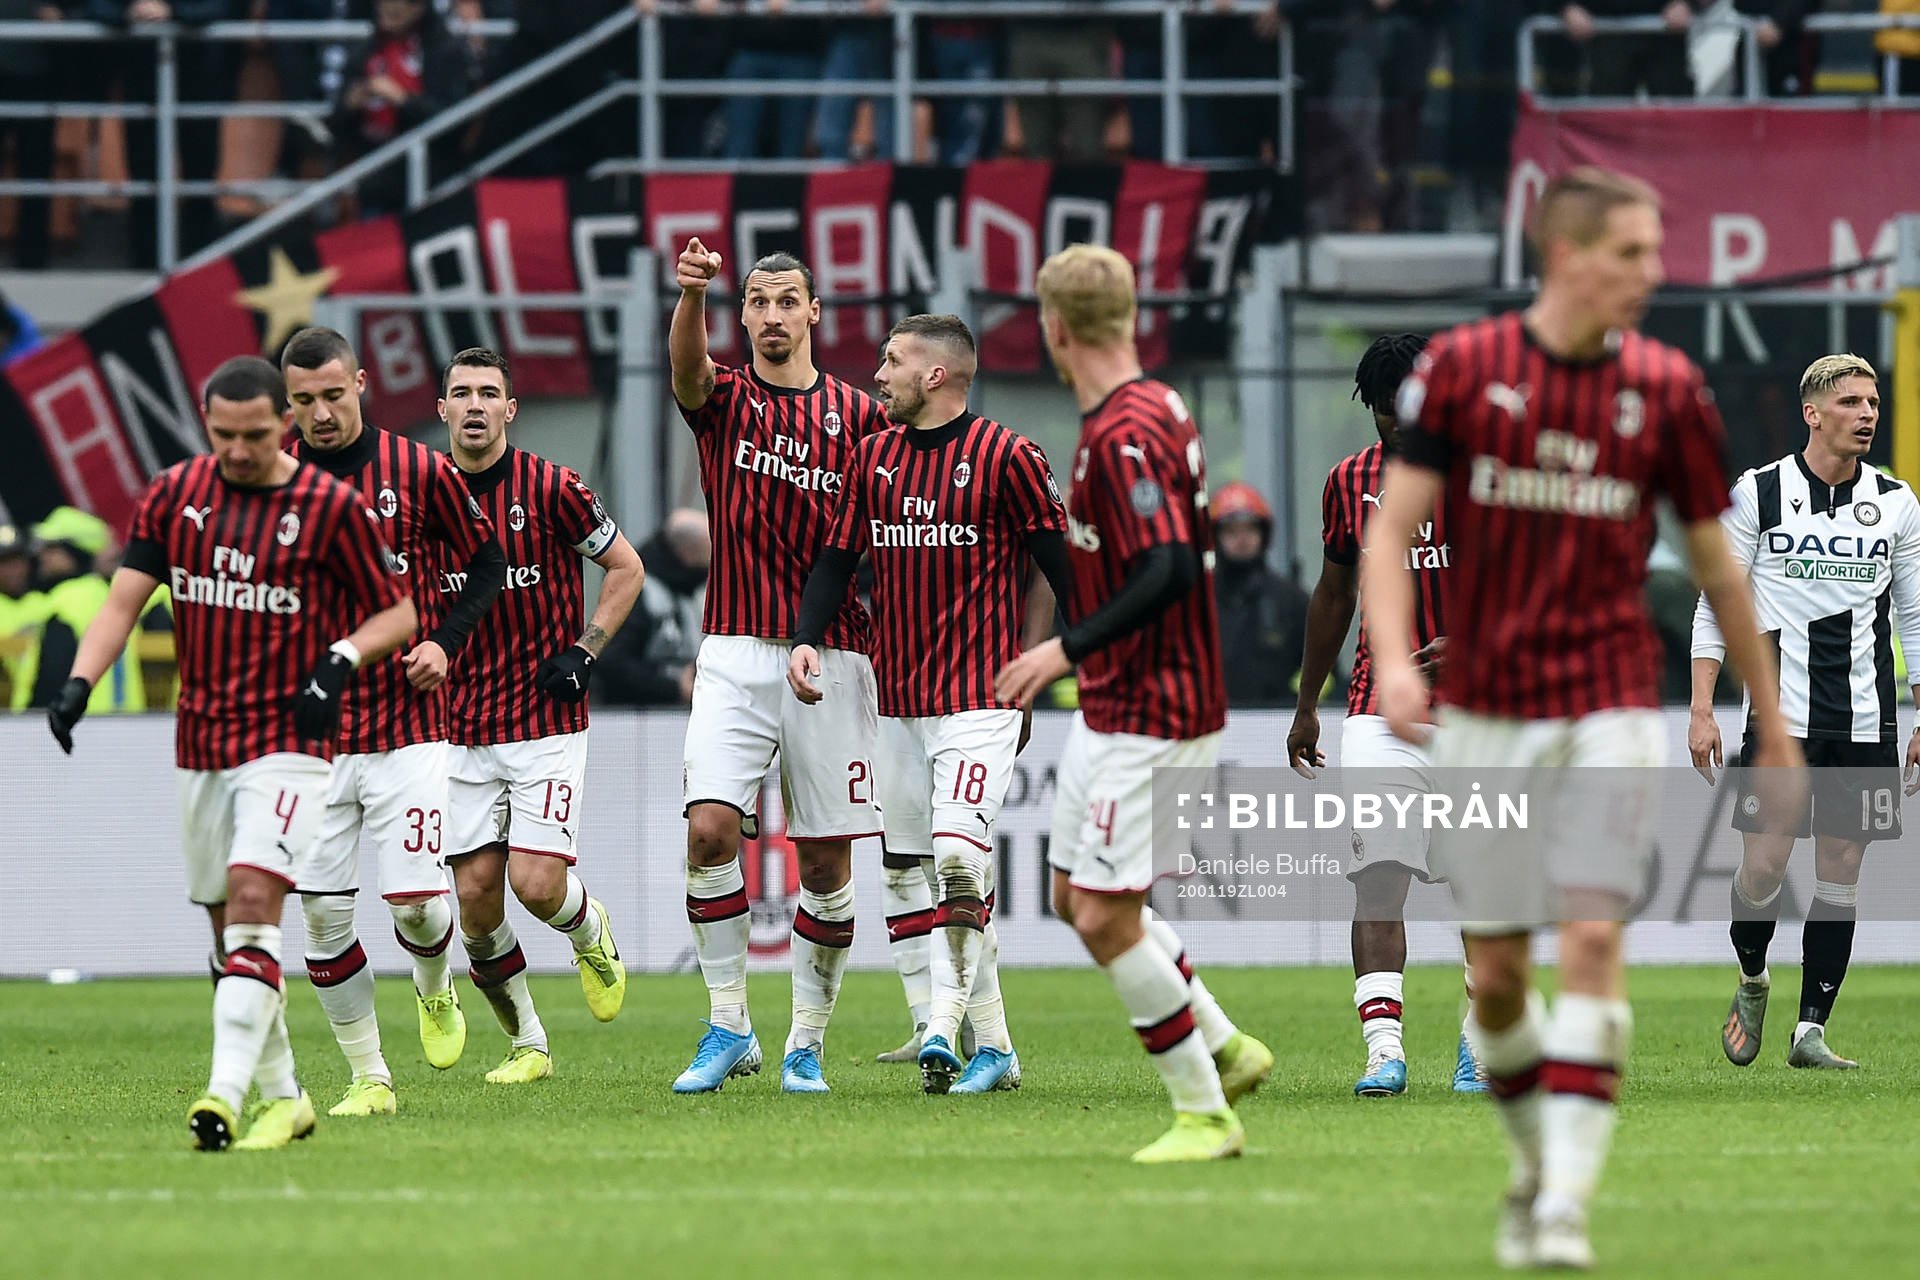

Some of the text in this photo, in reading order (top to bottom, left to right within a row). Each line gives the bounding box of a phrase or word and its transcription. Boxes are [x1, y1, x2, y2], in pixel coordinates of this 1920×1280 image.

[774, 433, 810, 463] Fly
[903, 496, 936, 520] Fly
[870, 517, 979, 547] Emirates
[1768, 532, 1889, 561] DACIA
[213, 546, 255, 579] Fly
[1819, 564, 1875, 579] VORTICE
[170, 565, 301, 614] Emirates
[542, 780, 572, 823] 13
[952, 760, 988, 805] 18
[274, 789, 299, 836] 4
[1861, 788, 1894, 831] 19
[402, 807, 442, 854] 33
